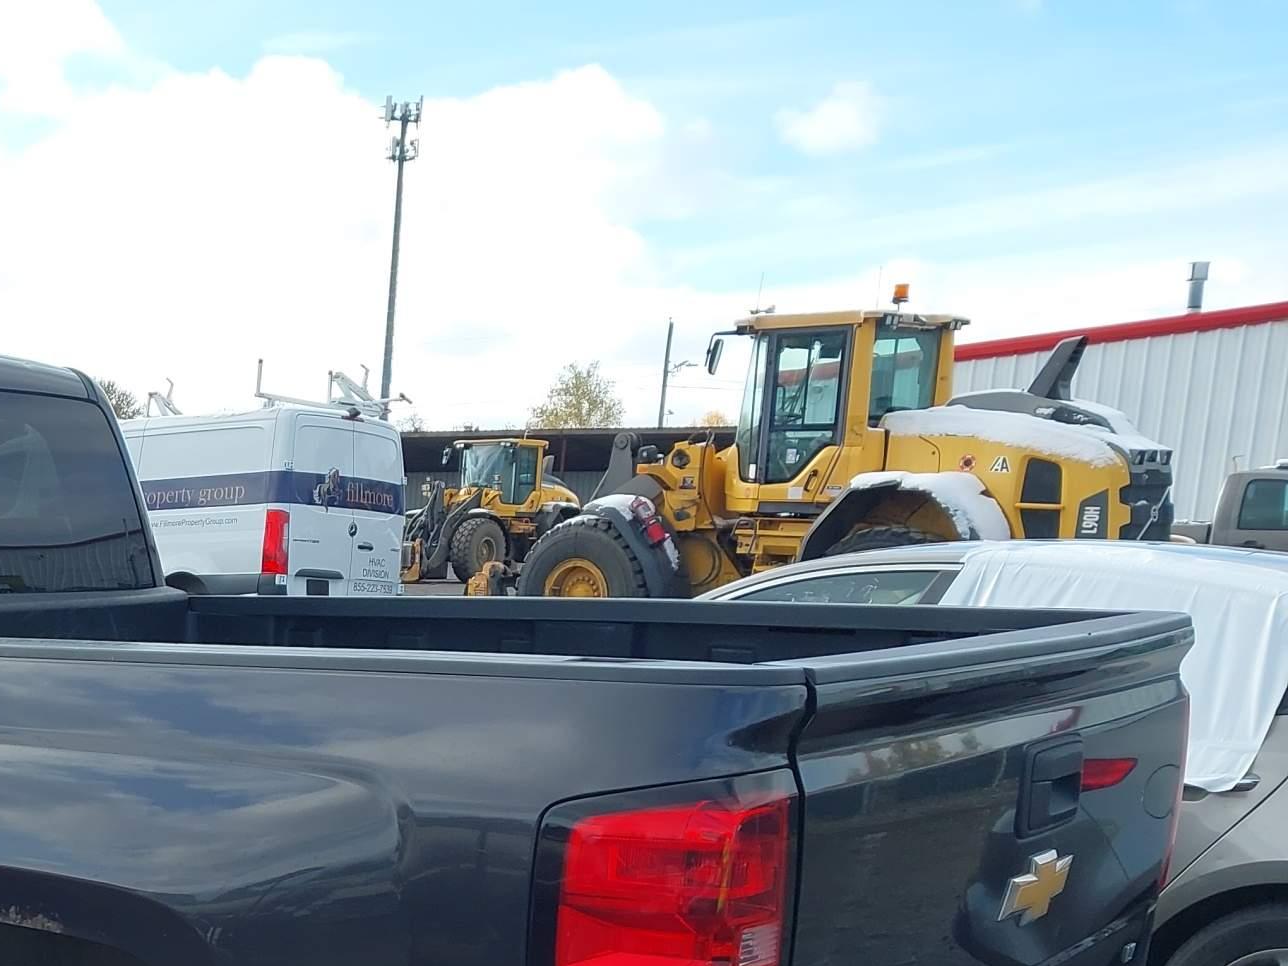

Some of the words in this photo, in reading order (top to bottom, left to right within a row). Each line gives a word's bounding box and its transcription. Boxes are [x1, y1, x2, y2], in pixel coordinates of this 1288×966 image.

[198, 485, 246, 506] group
[346, 481, 394, 507] fillmore
[1081, 506, 1101, 534] L90H
[368, 557, 386, 568] HVAC
[362, 568, 390, 580] DIVISION
